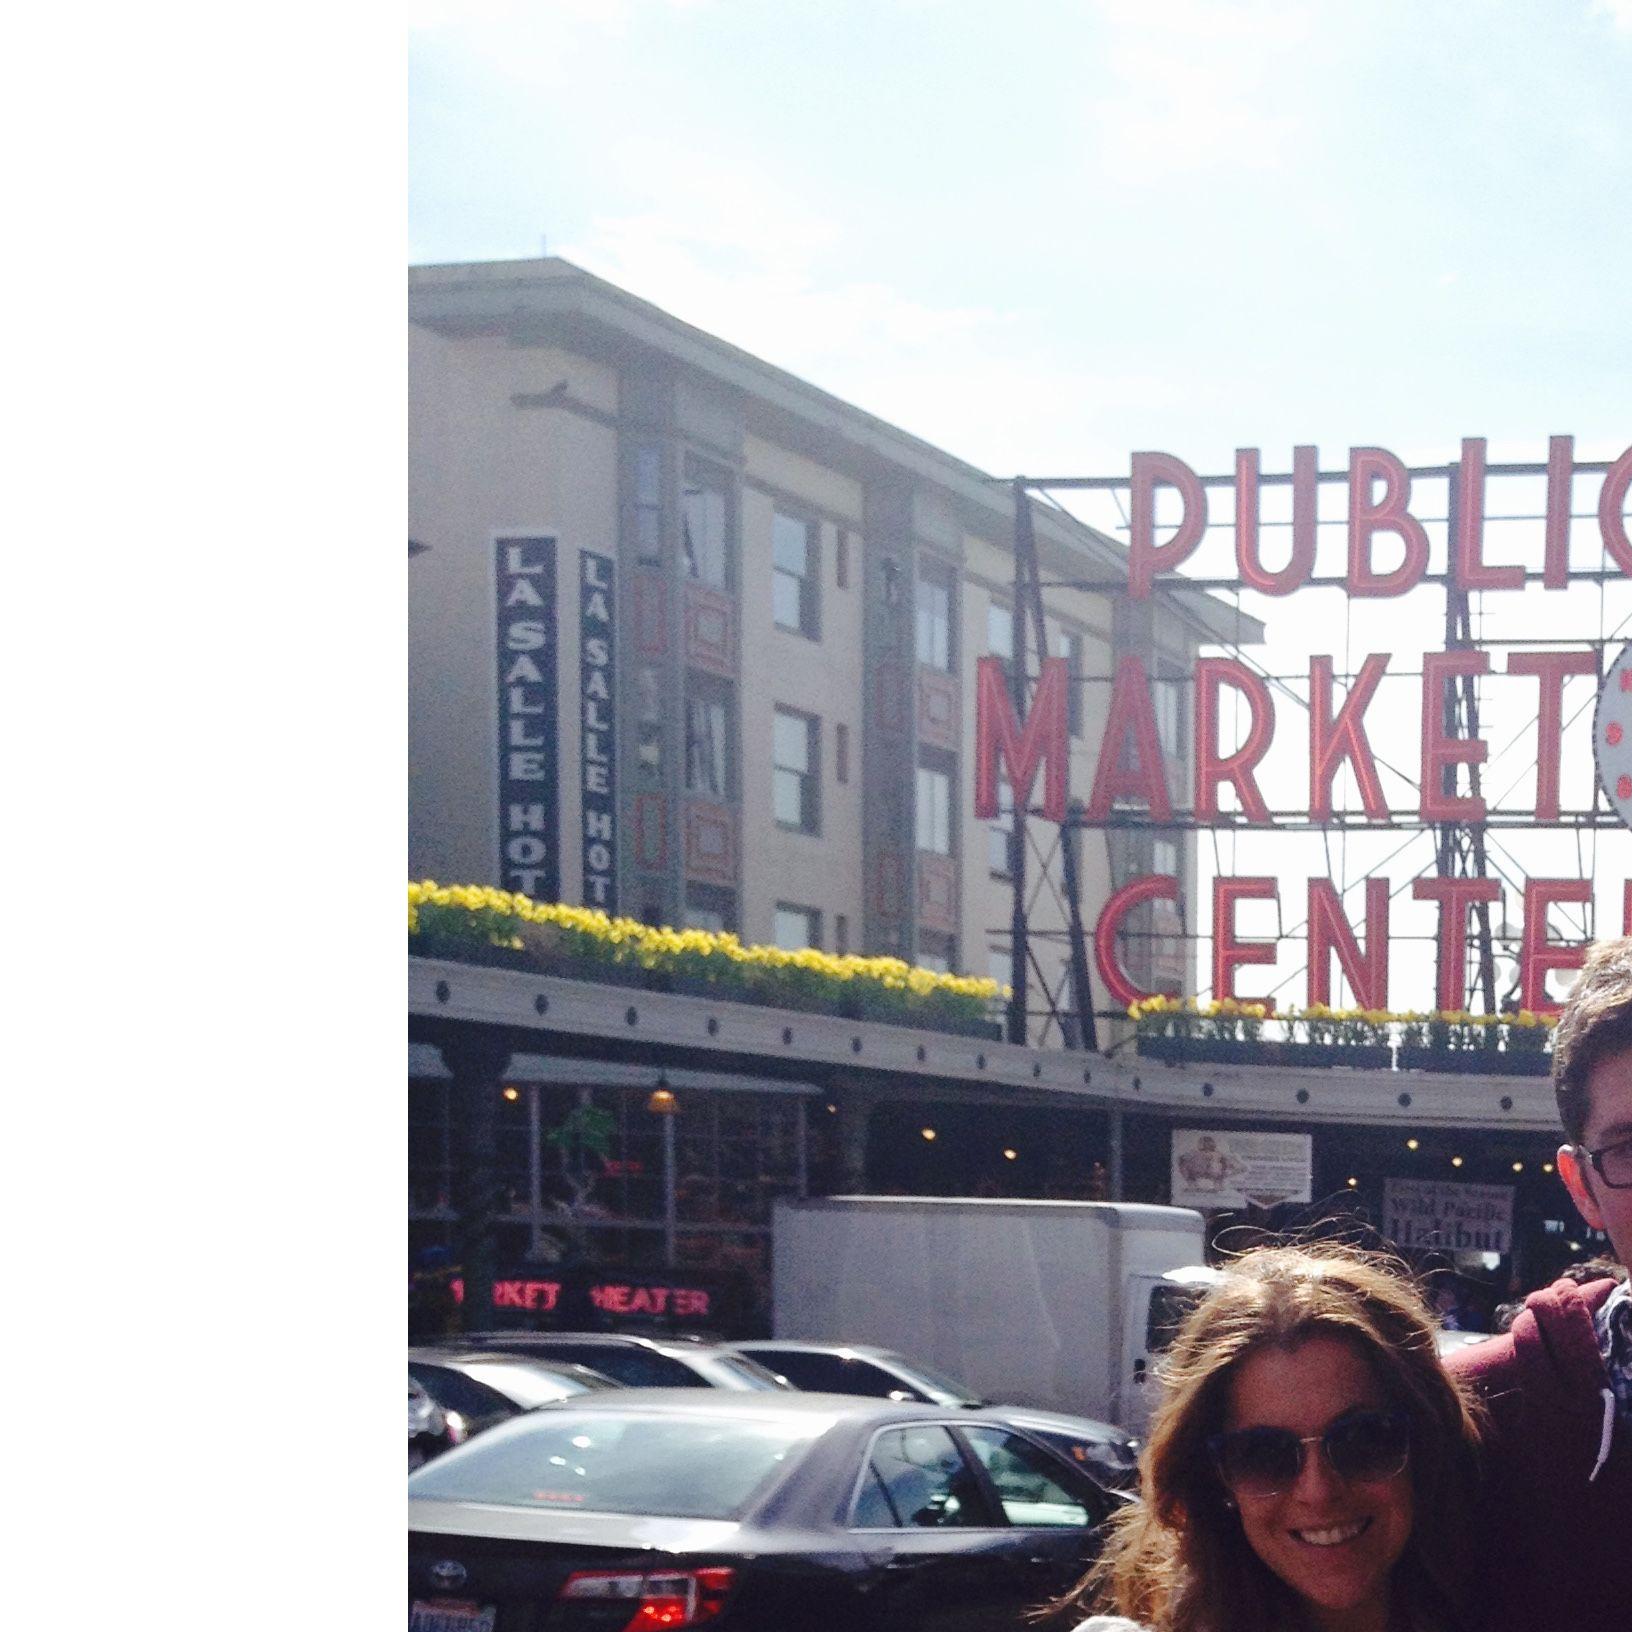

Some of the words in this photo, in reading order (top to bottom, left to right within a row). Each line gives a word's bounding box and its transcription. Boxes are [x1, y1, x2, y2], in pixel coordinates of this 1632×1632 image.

[974, 652, 1598, 823] MARKET
[507, 802, 547, 897] HOT
[586, 808, 612, 903] HOT
